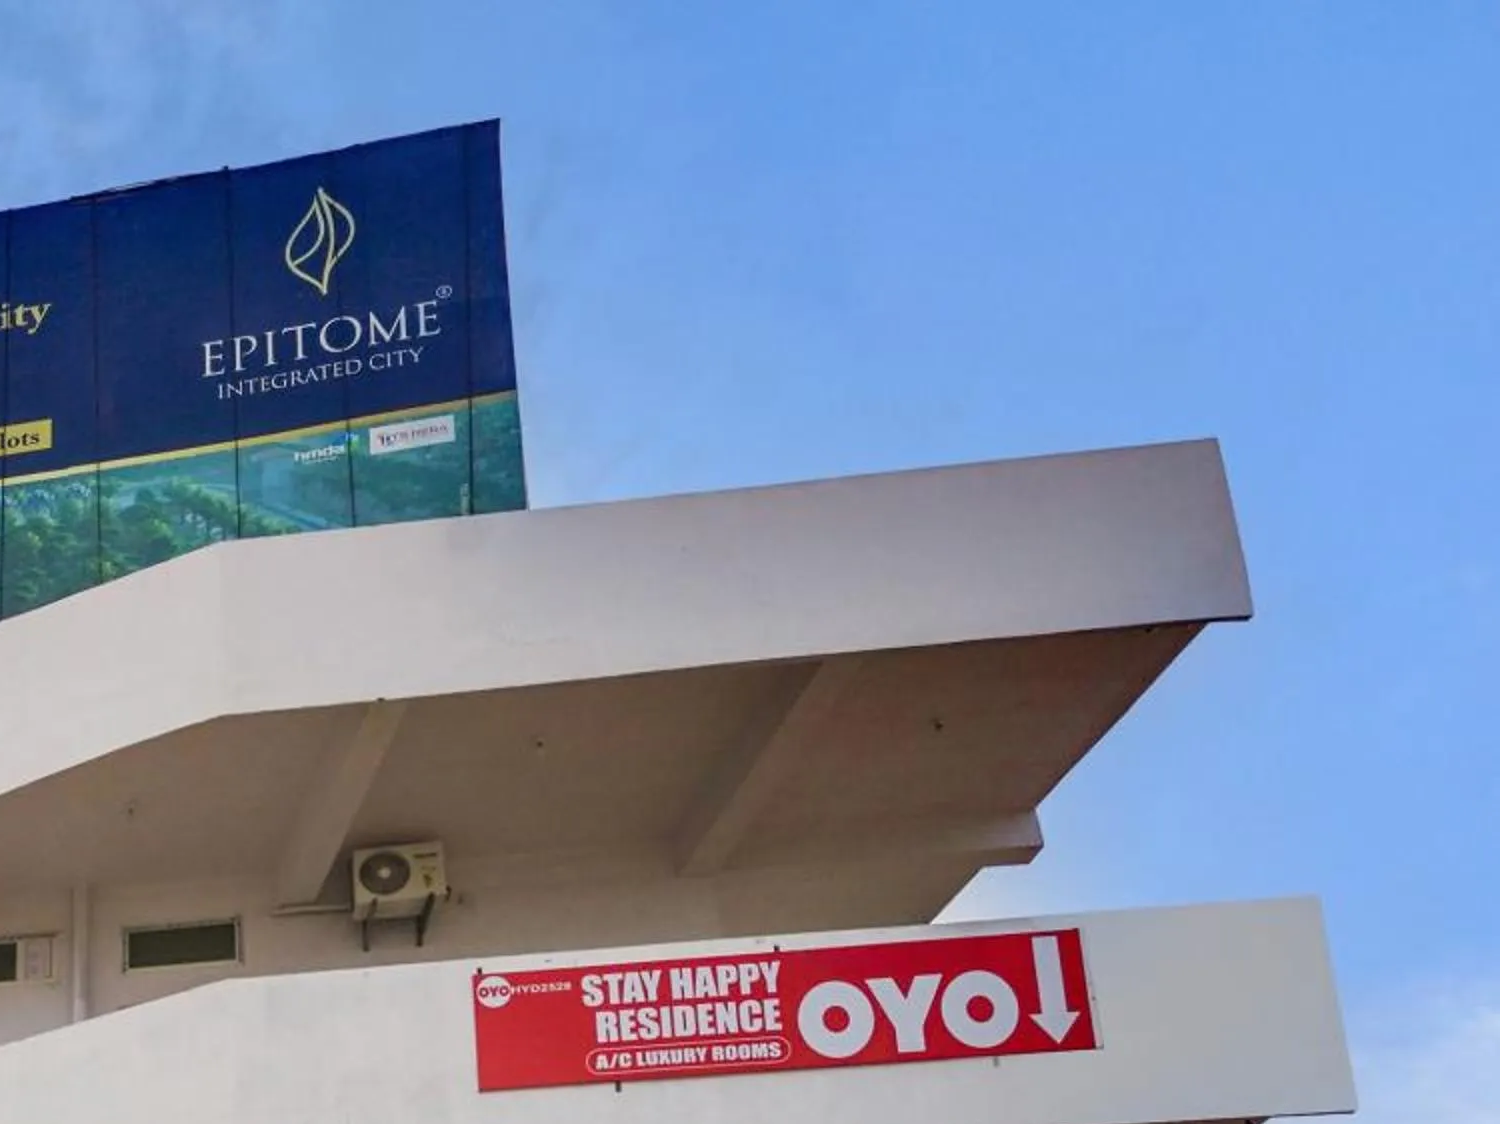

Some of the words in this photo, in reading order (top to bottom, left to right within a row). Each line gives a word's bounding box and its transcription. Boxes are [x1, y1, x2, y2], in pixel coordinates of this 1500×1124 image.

[202, 300, 442, 378] EPITOME
[218, 358, 363, 399] INTEGRATED
[369, 347, 424, 371] CITY
[479, 983, 510, 998] OYO
[581, 972, 661, 1007] STAY
[668, 960, 781, 1000] HAPPY
[595, 999, 783, 1043] RESIDENCE
[798, 970, 1019, 1059] OYO
[595, 1050, 634, 1070] A/C
[636, 1047, 709, 1067] LUXURY
[711, 1042, 782, 1061] ROOMS
